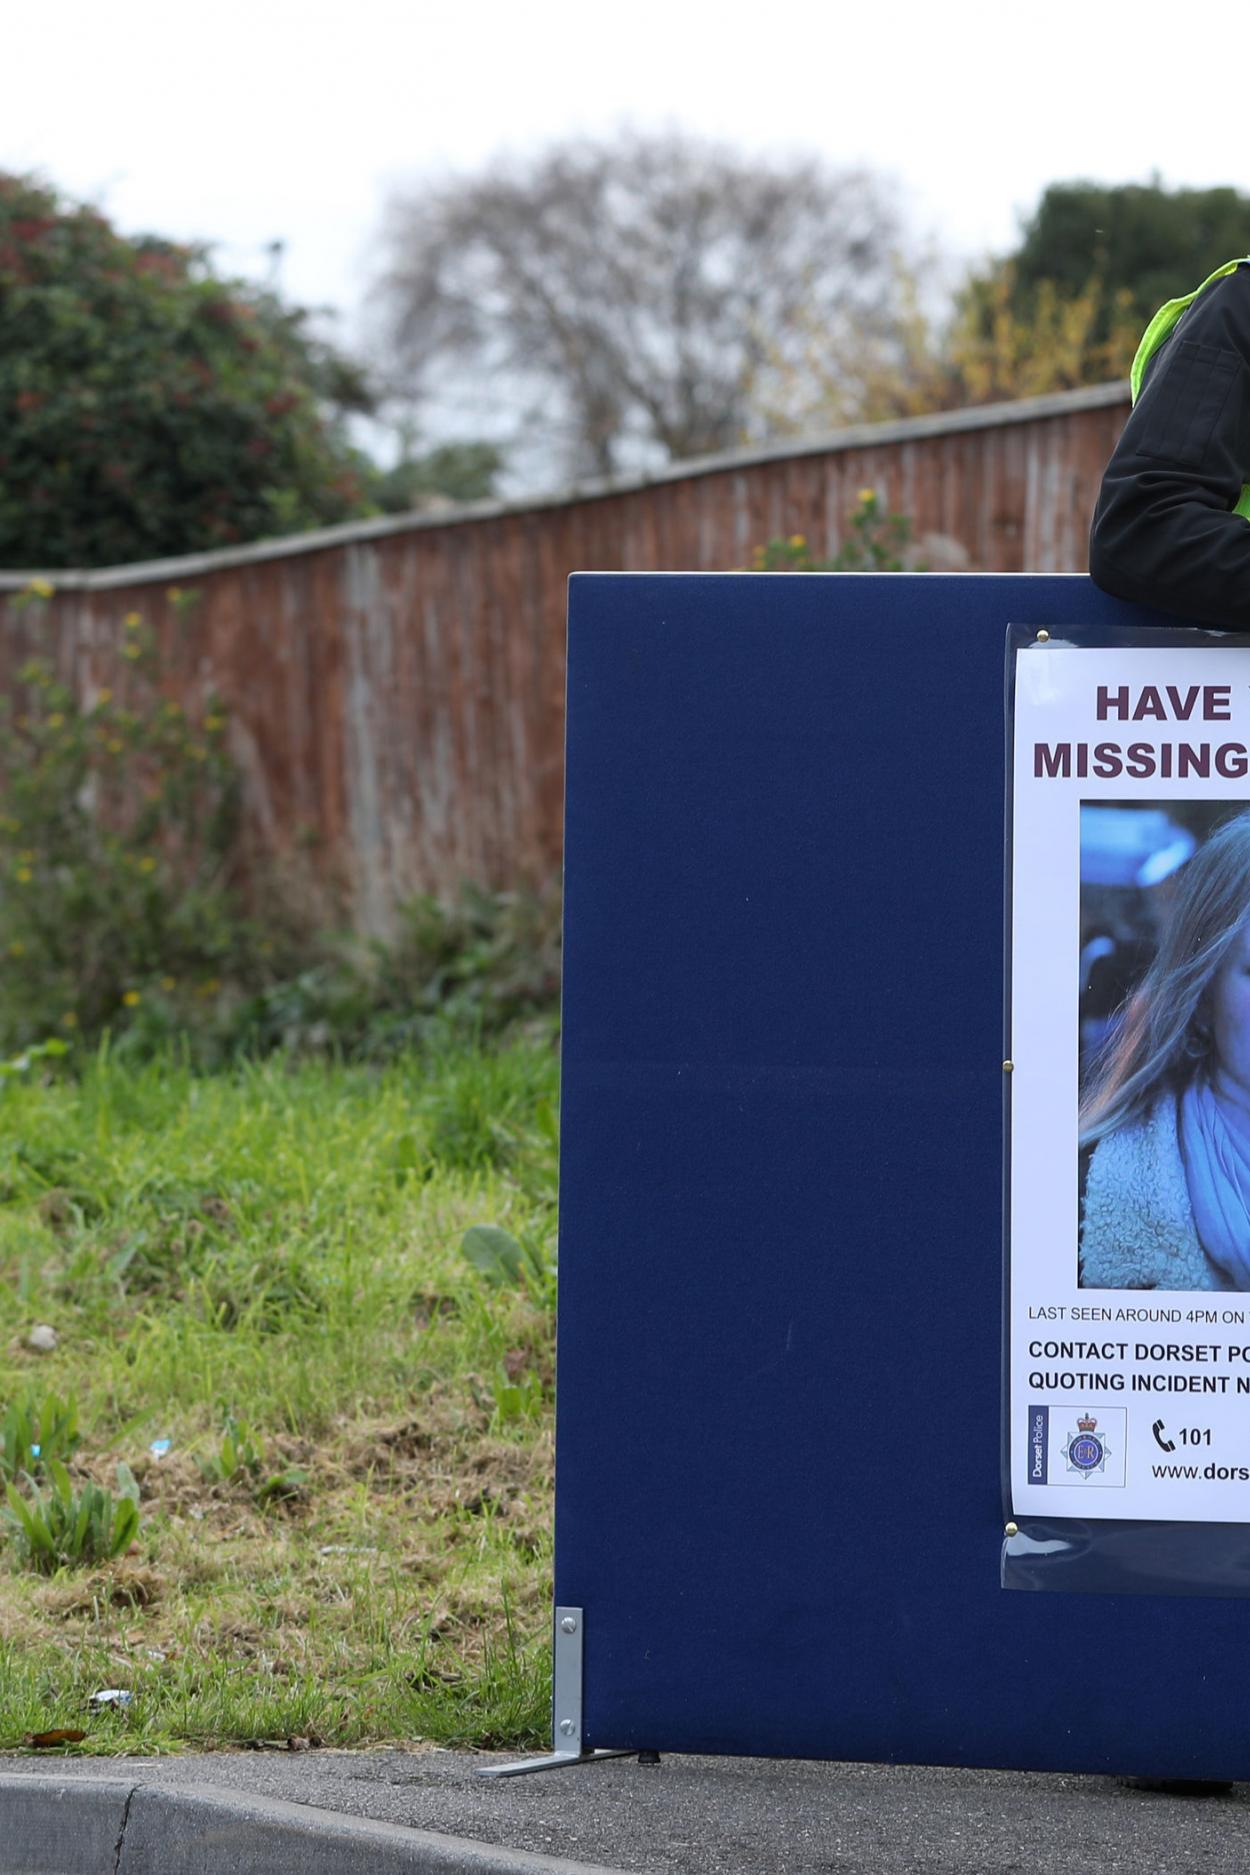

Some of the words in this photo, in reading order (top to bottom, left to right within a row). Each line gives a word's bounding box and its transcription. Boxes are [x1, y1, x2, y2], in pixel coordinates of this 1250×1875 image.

[1096, 685, 1232, 721] HAVE
[1033, 742, 1249, 779] MISSING
[1028, 1306, 1067, 1320] LAST
[1070, 1306, 1112, 1321] SEEN
[1115, 1308, 1182, 1323] AROUND
[1185, 1309, 1218, 1324] 4PM
[1221, 1310, 1245, 1325] ON
[1028, 1340, 1129, 1360] CONTACT
[1135, 1343, 1222, 1363] DORSET
[1028, 1371, 1125, 1392] QUOTING
[1131, 1374, 1231, 1394] INCIDENT
[1033, 1414, 1044, 1443] Police
[1178, 1427, 1212, 1446] 101
[1032, 1444, 1043, 1478] Dorset
